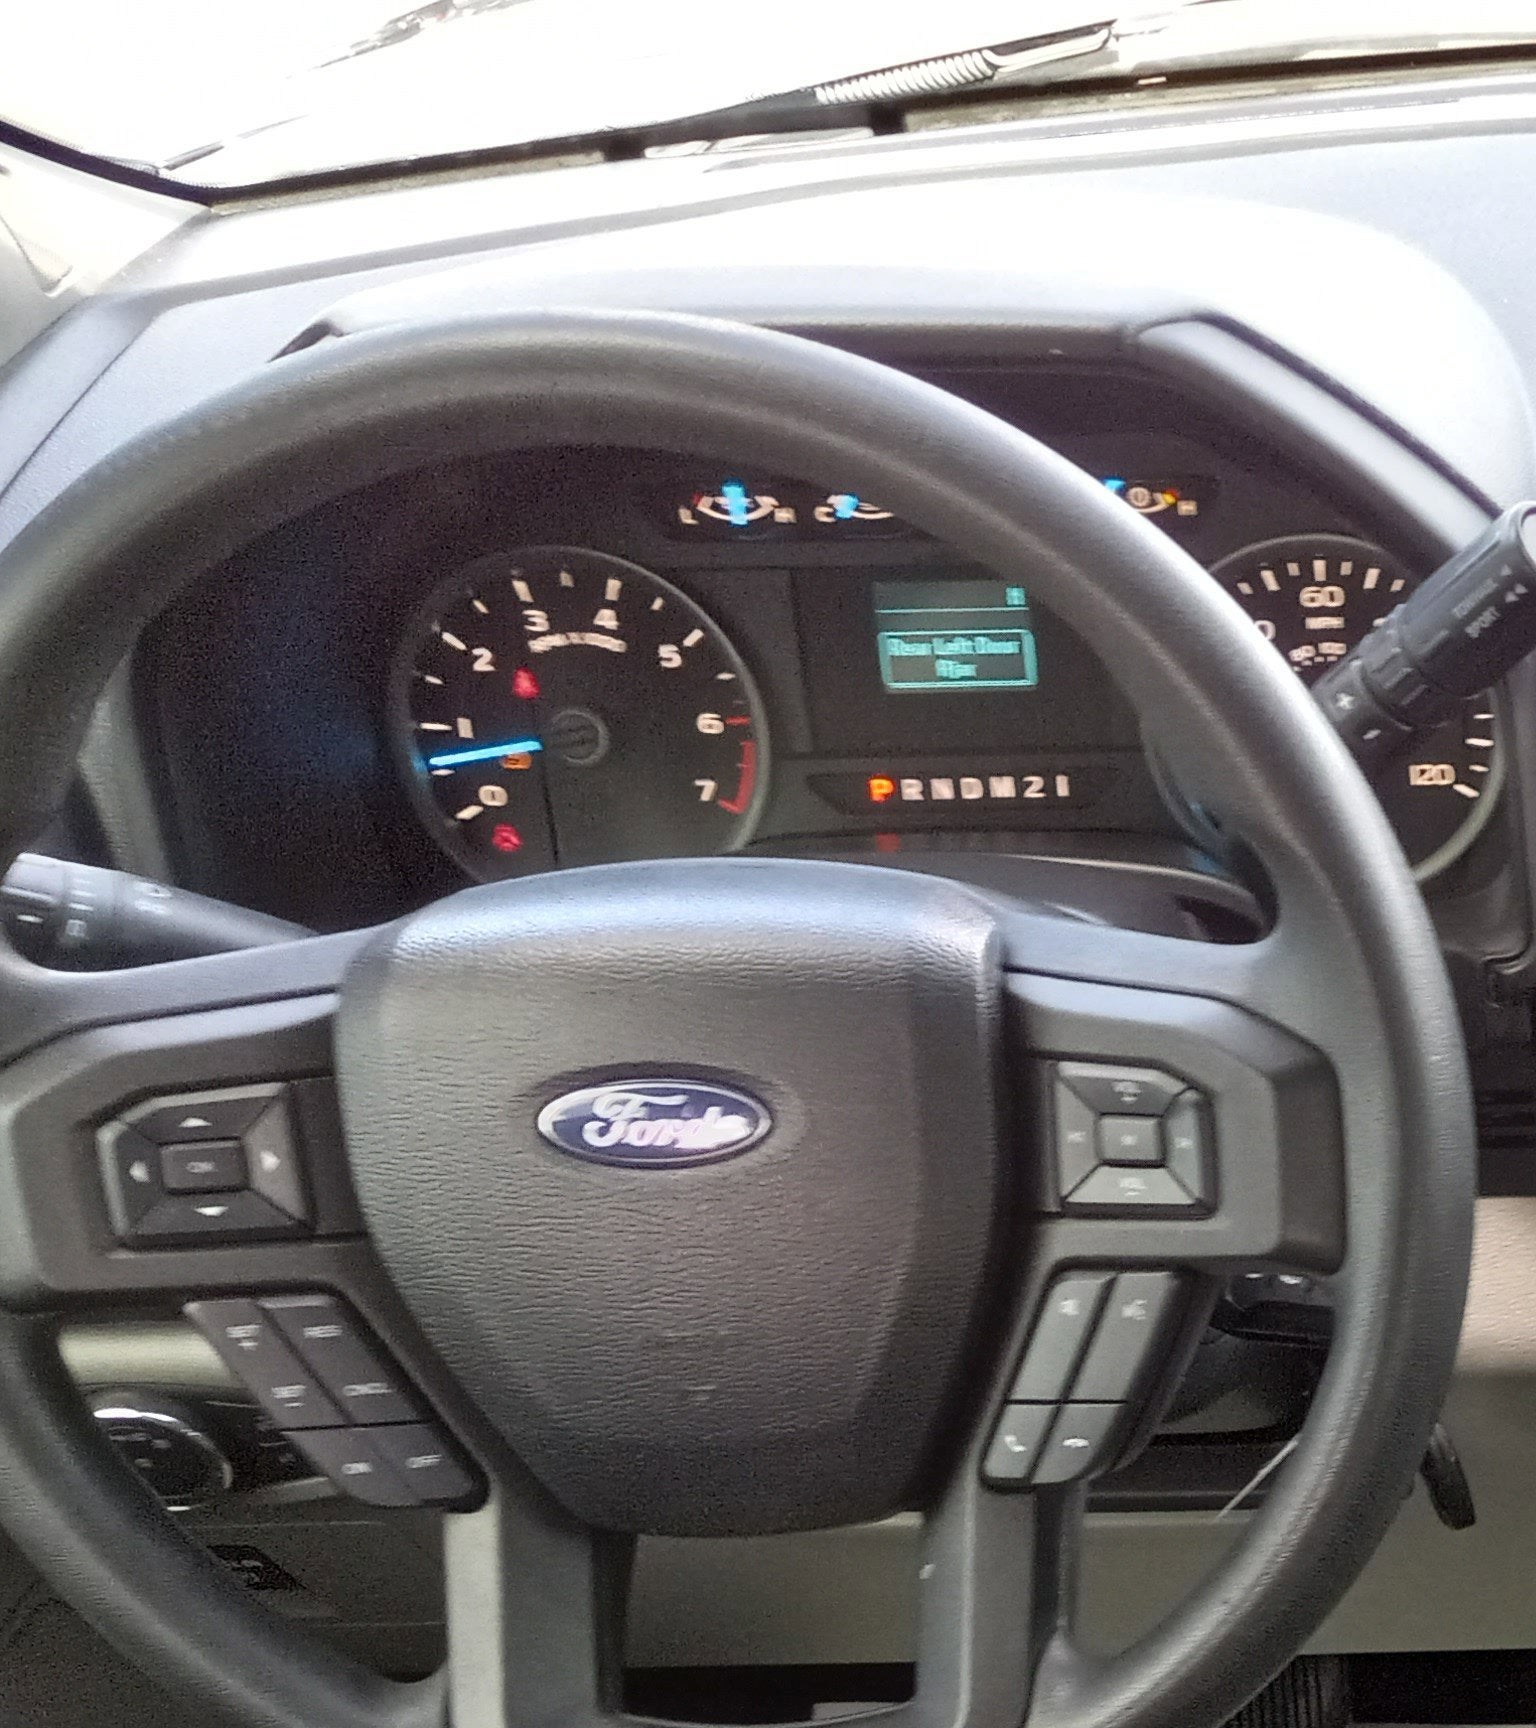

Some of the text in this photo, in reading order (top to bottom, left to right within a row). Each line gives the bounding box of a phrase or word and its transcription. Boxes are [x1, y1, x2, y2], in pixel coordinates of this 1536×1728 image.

[1300, 586, 1345, 607] 60
[522, 610, 549, 631] 3
[593, 609, 619, 630] 4
[472, 648, 496, 671] 2
[658, 644, 682, 668] 5
[696, 713, 725, 734] 6
[478, 785, 508, 806] 0
[694, 779, 718, 801] 7
[867, 778, 895, 802] P
[900, 778, 925, 800] R
[960, 777, 984, 800] D
[1022, 776, 1047, 798] 2
[582, 1092, 751, 1149] Ford
